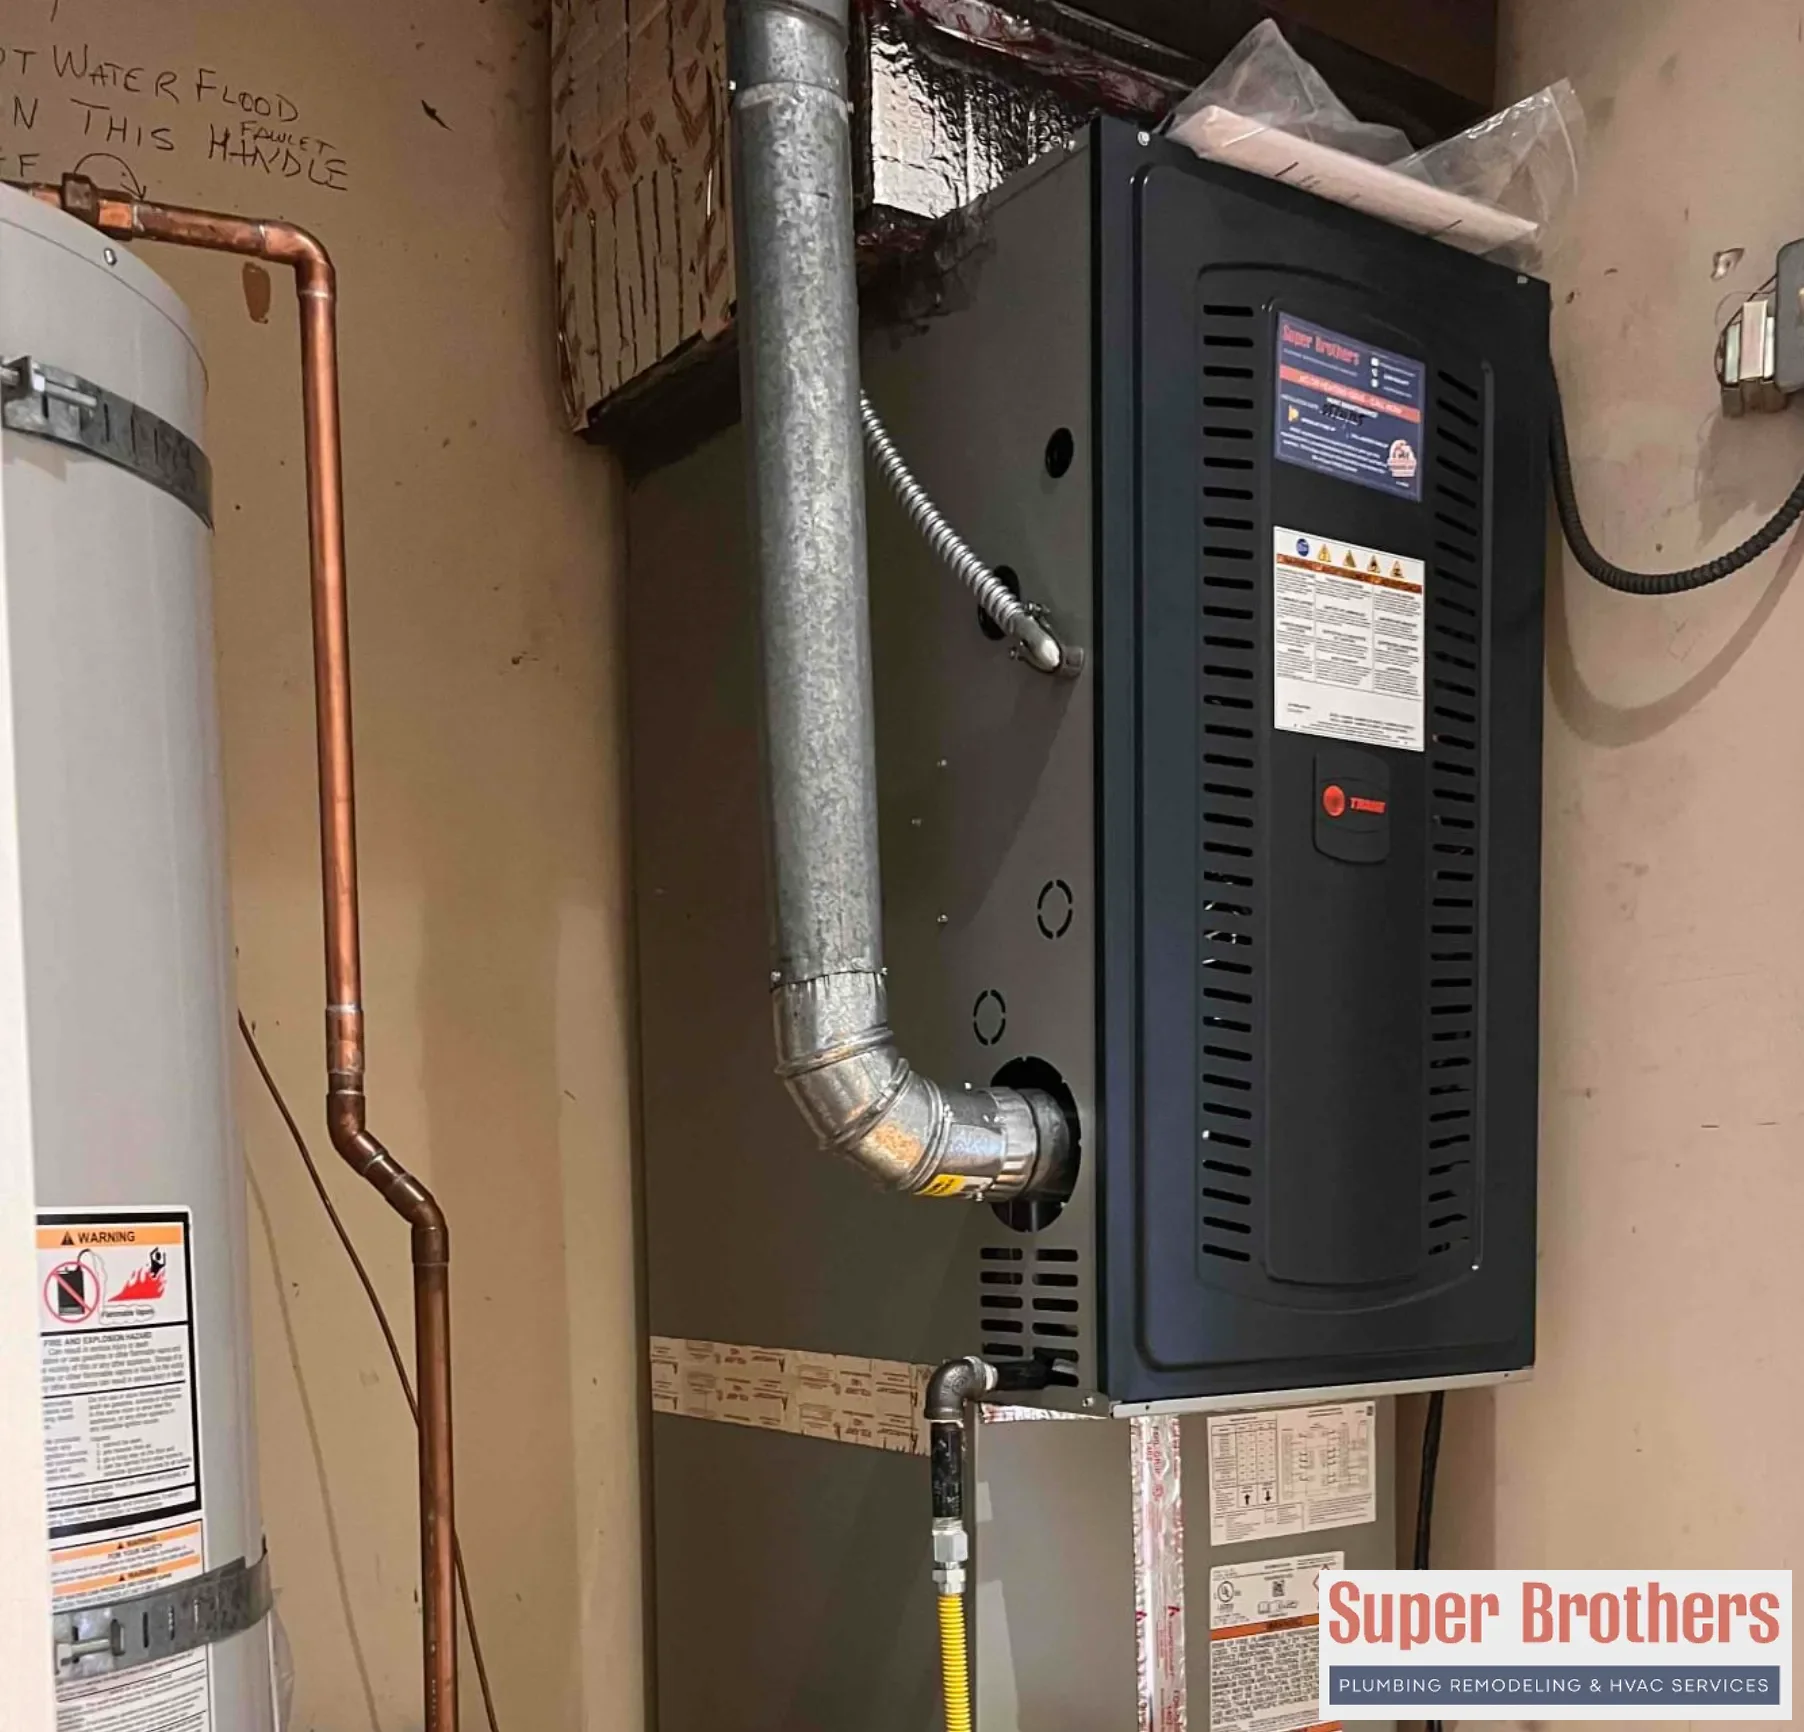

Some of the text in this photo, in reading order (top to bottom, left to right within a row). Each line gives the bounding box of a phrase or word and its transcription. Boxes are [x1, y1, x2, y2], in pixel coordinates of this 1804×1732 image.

[53, 43, 180, 103] WATER
[196, 68, 300, 123] FLOOD
[71, 98, 175, 151] THIS
[208, 122, 349, 191] HANDLE
[77, 1231, 136, 1243] WARNING
[64, 1337, 81, 1346] AND
